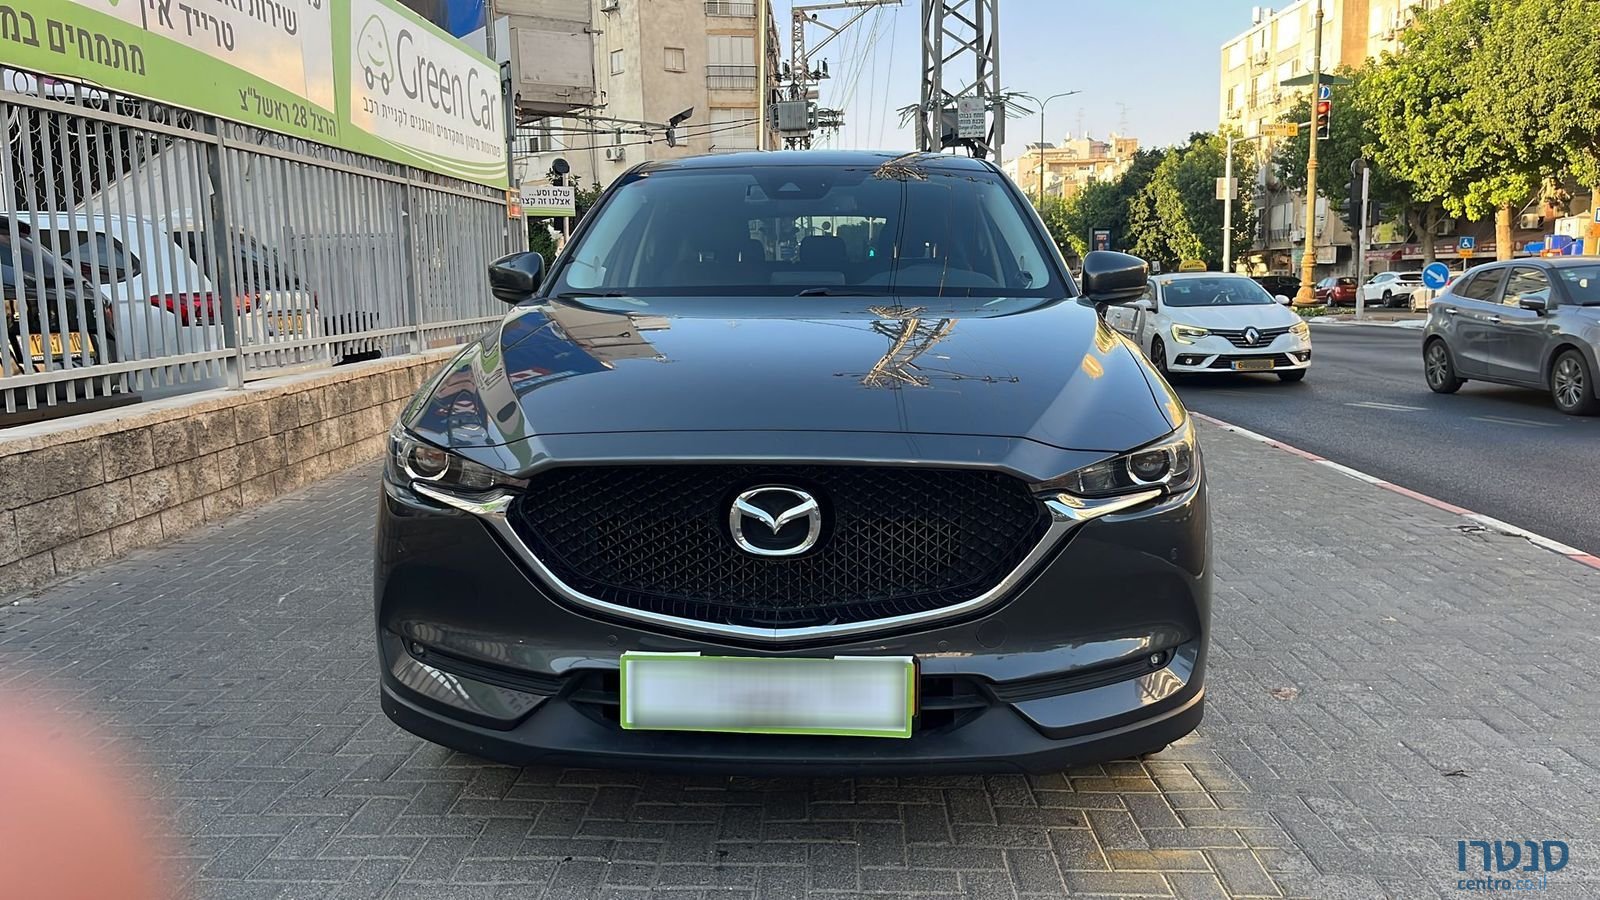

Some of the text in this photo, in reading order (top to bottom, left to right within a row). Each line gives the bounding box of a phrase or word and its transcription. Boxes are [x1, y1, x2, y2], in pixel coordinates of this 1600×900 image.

[179, 3, 235, 52] טרייד
[248, 0, 297, 36] שירות
[46, 18, 146, 76] מתמחים
[396, 29, 496, 133] Green Car
[292, 103, 307, 128] 28
[362, 96, 380, 116] רכב
[382, 103, 408, 129] לקניית
[309, 106, 337, 137] הרצל
[410, 114, 435, 134] והוגנים
[436, 124, 465, 147] מתקדמים
[537, 197, 547, 205] זה
[549, 196, 571, 206] אצלנו
[552, 188, 570, 197] שלם
